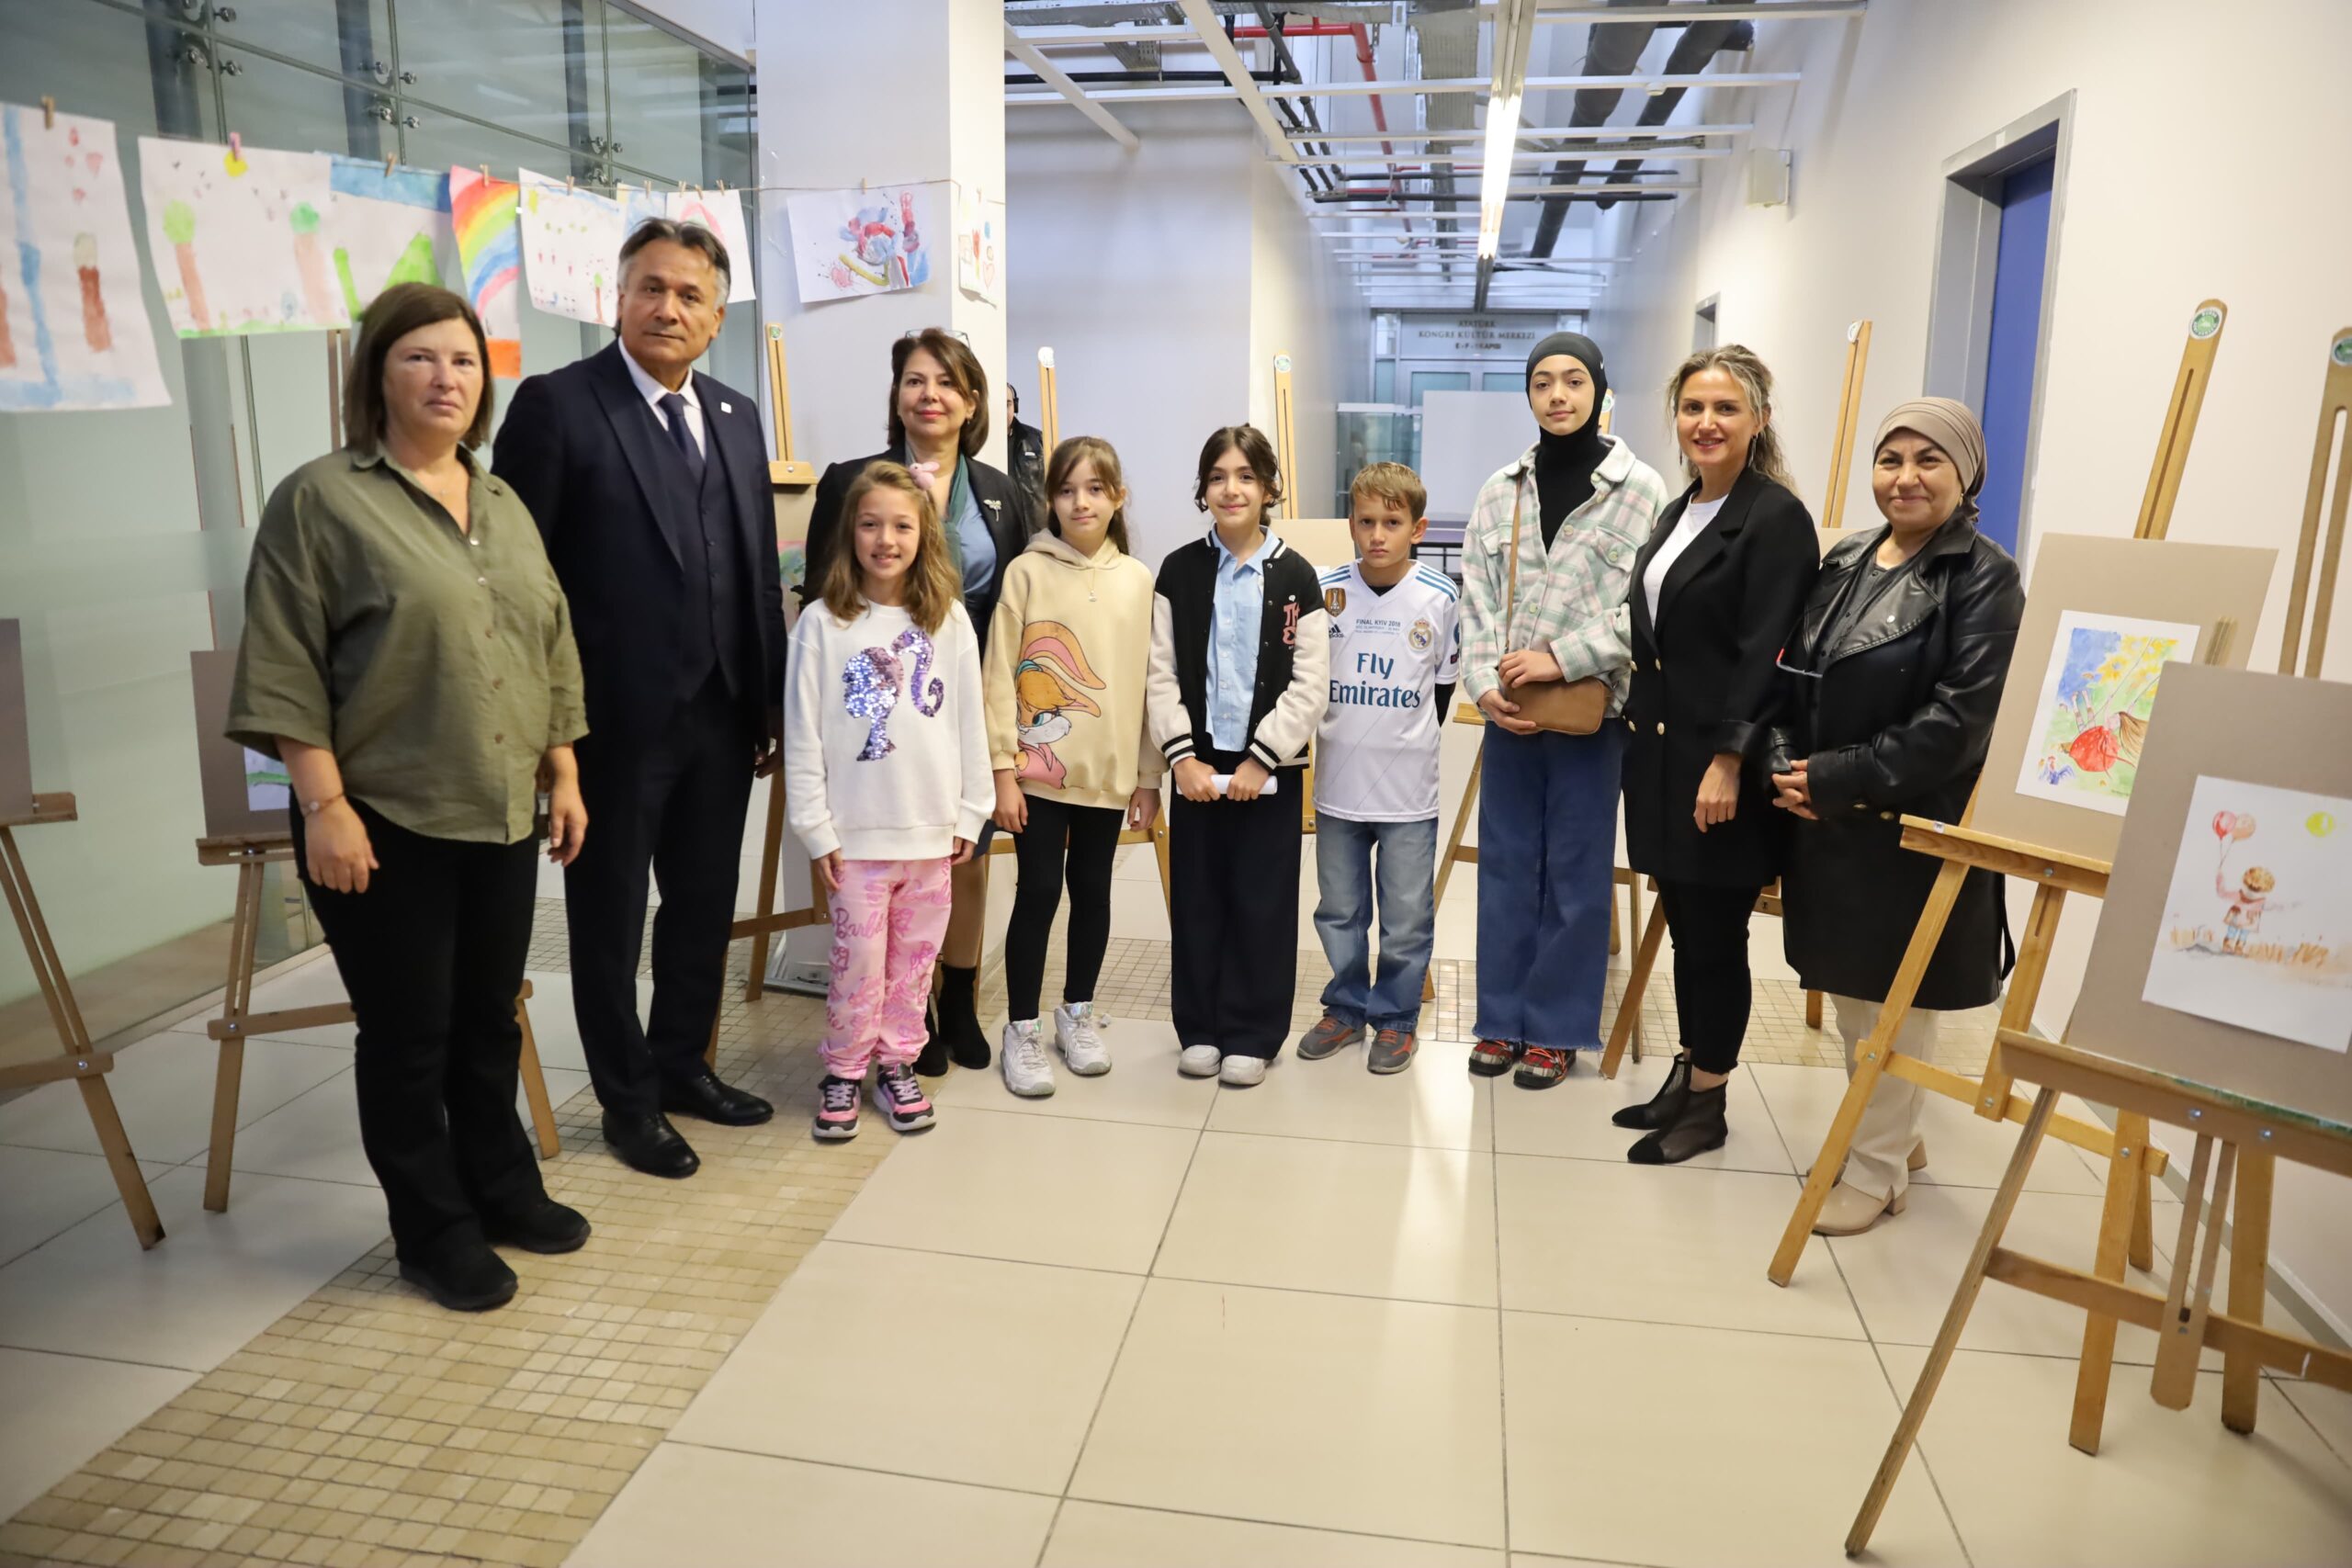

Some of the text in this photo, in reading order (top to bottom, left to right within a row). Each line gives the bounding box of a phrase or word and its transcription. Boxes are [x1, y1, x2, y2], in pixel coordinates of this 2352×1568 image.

[1458, 320, 1496, 328] ATATÜRK
[1419, 331, 1454, 339] KONGRE
[1457, 330, 1495, 339] KÜLTÜR
[1357, 652, 1394, 680] Fly
[1329, 680, 1420, 708] Emirates
